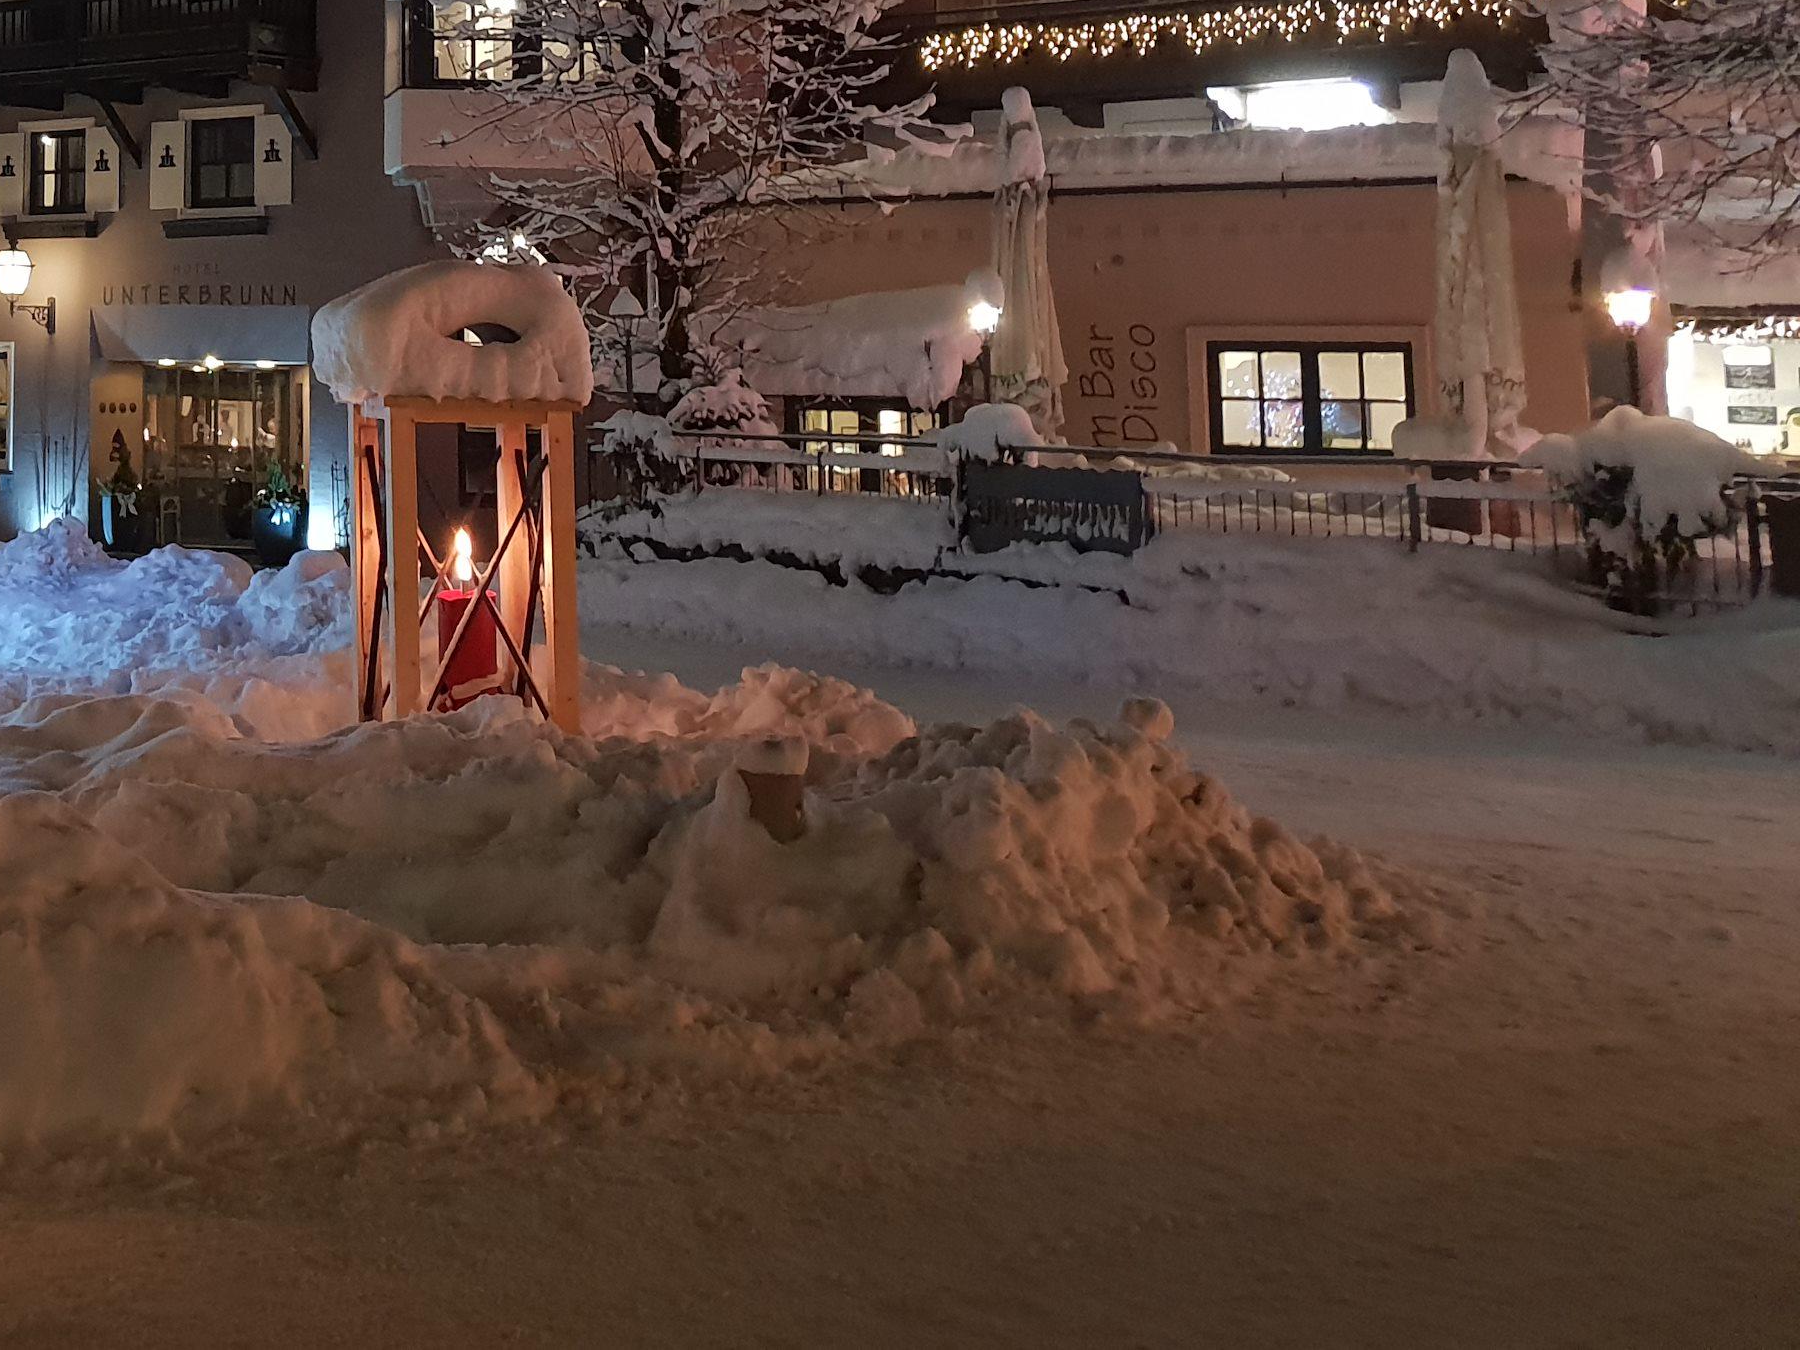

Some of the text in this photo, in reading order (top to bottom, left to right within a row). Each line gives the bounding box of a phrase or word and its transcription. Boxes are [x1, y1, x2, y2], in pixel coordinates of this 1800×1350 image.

[173, 263, 221, 275] HOTEL
[102, 284, 297, 306] UNTERBRUNN
[1079, 322, 1115, 399] Bar
[1121, 324, 1158, 442] Disco
